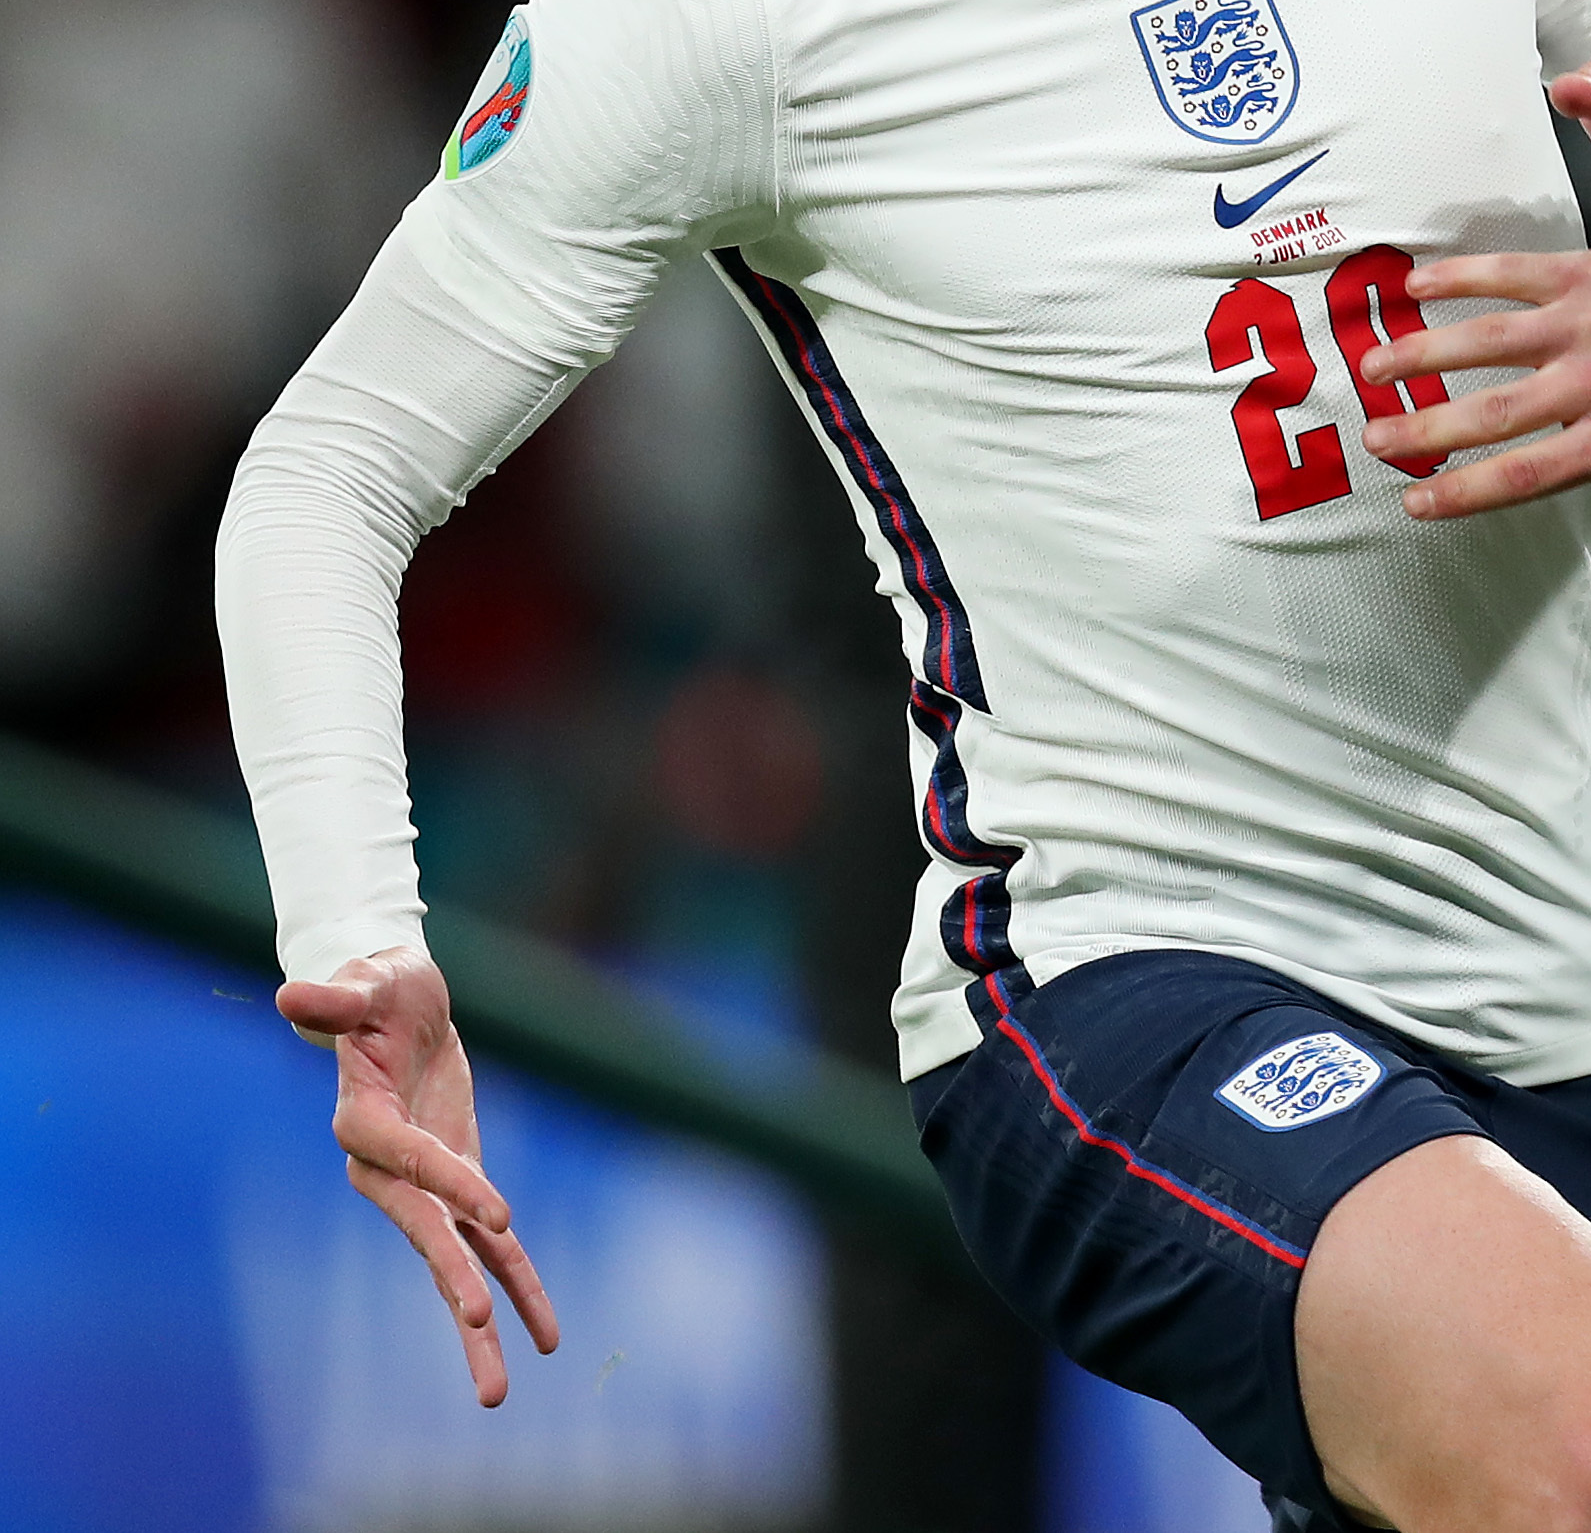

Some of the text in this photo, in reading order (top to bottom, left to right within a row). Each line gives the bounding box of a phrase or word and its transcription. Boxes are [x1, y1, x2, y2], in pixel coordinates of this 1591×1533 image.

[1250, 207, 1329, 248] DENMARK
[1269, 239, 1306, 264] JULY
[1311, 227, 1347, 250] 2021
[1204, 243, 1451, 522] 20
